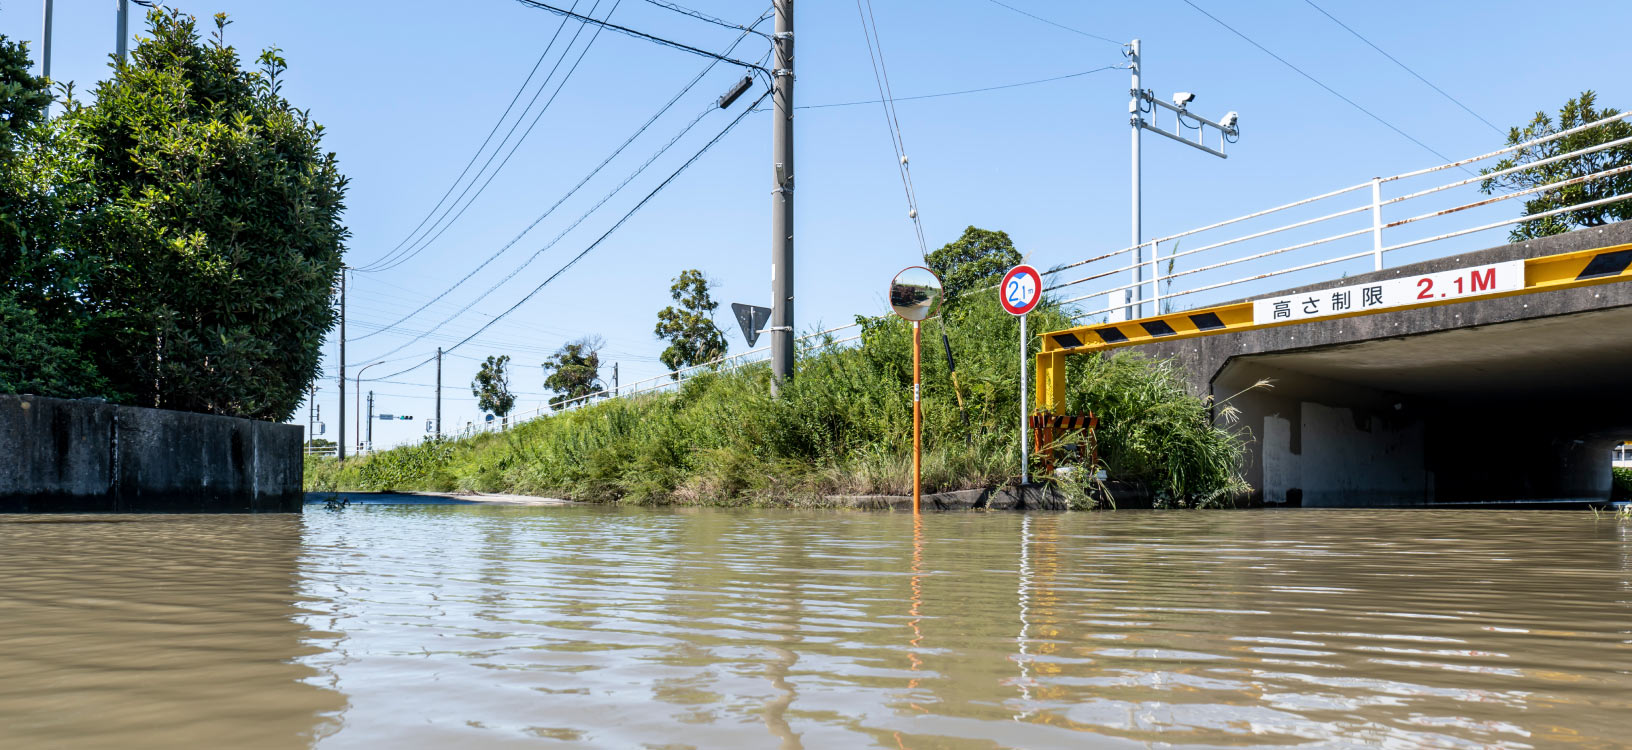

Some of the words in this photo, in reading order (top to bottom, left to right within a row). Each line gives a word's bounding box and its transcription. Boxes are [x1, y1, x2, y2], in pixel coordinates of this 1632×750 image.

[1273, 286, 1383, 319] 高さ制限
[1417, 268, 1496, 300] 2.1M
